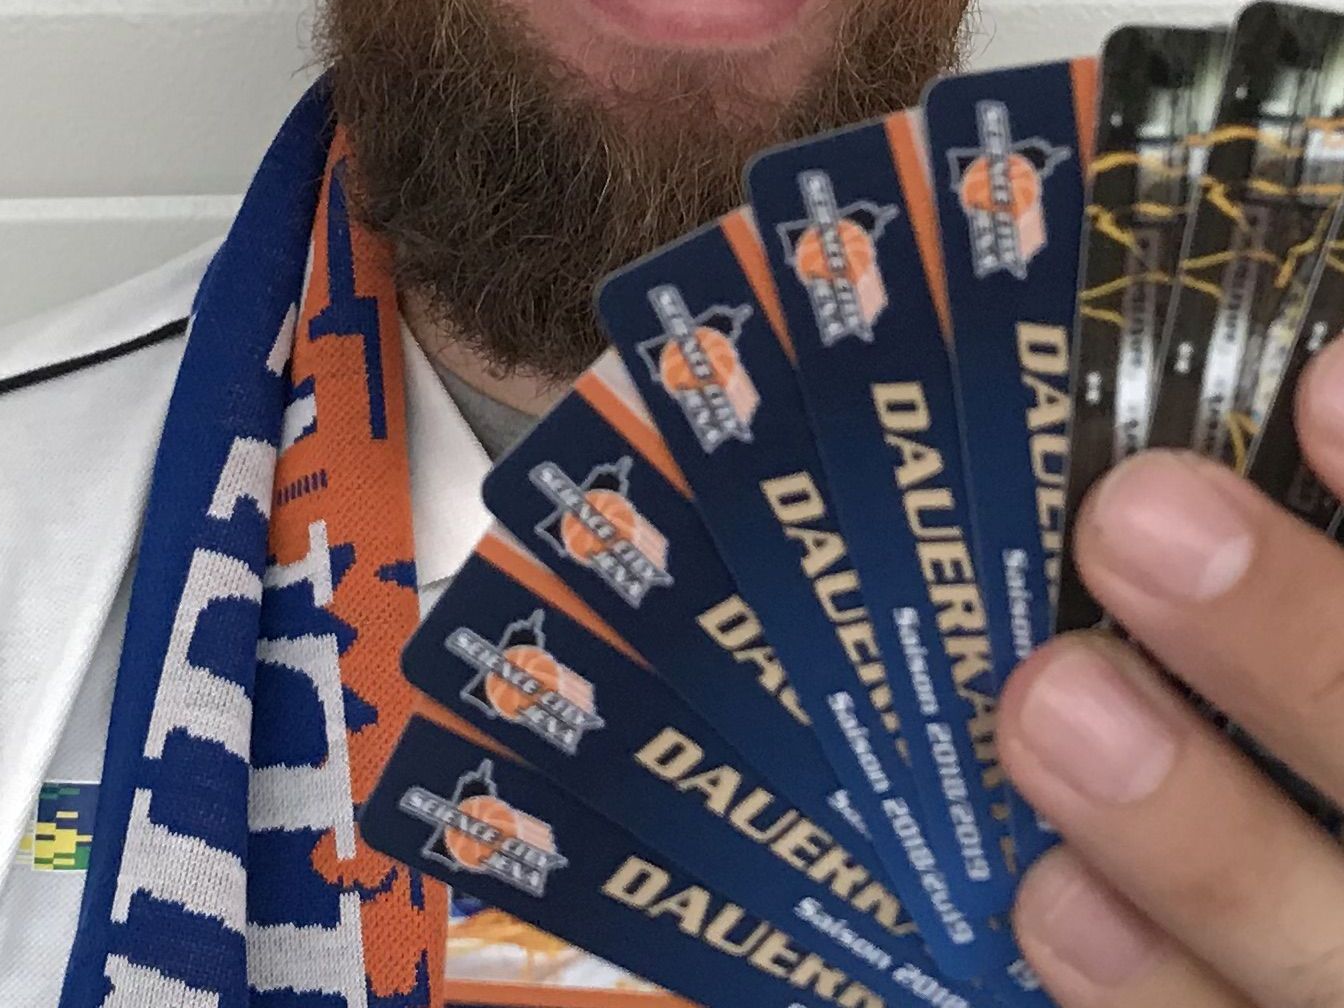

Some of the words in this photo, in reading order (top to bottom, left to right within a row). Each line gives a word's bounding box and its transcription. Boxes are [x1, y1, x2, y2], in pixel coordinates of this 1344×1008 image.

[827, 691, 891, 793] Saison
[893, 606, 940, 716] Saison
[925, 722, 991, 881] 2018/2019
[793, 896, 892, 970] Saison
